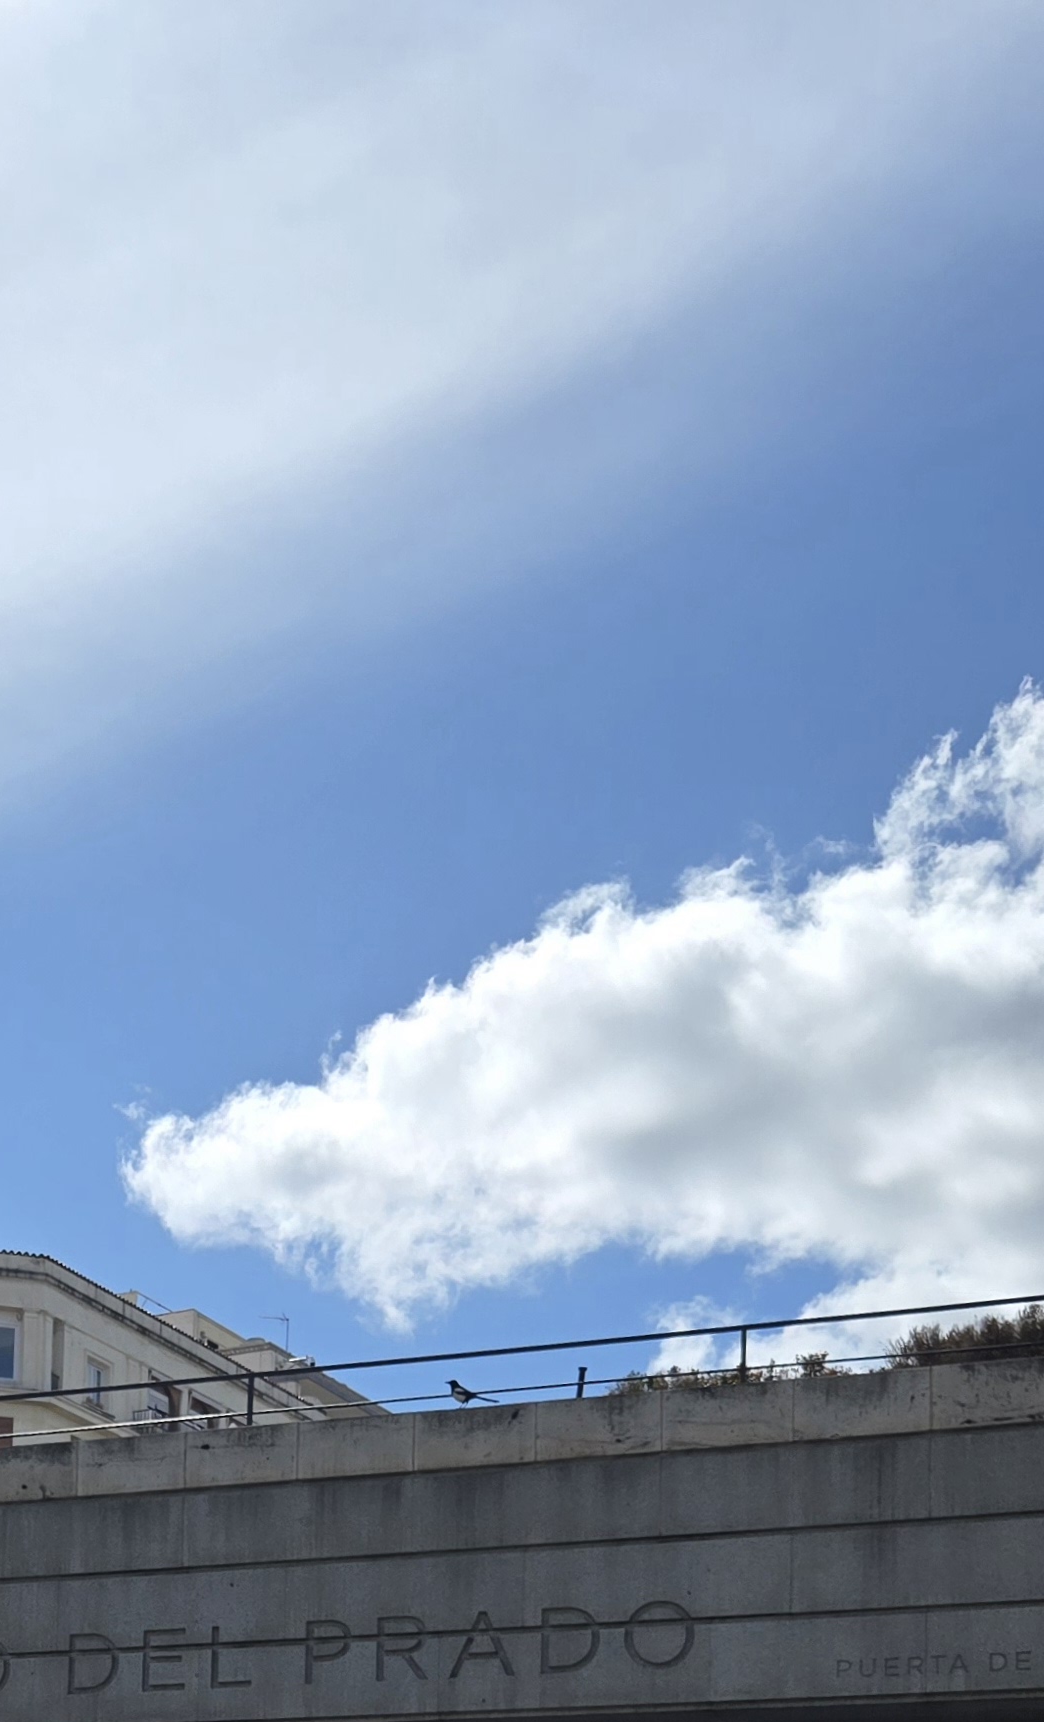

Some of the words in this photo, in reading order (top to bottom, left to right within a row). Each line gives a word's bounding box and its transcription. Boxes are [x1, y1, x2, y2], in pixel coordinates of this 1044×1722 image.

[66, 1626, 252, 1695] DEL
[304, 1601, 695, 1684] PRADO
[836, 1653, 969, 1677] PUERTA
[988, 1650, 1032, 1671] DE
